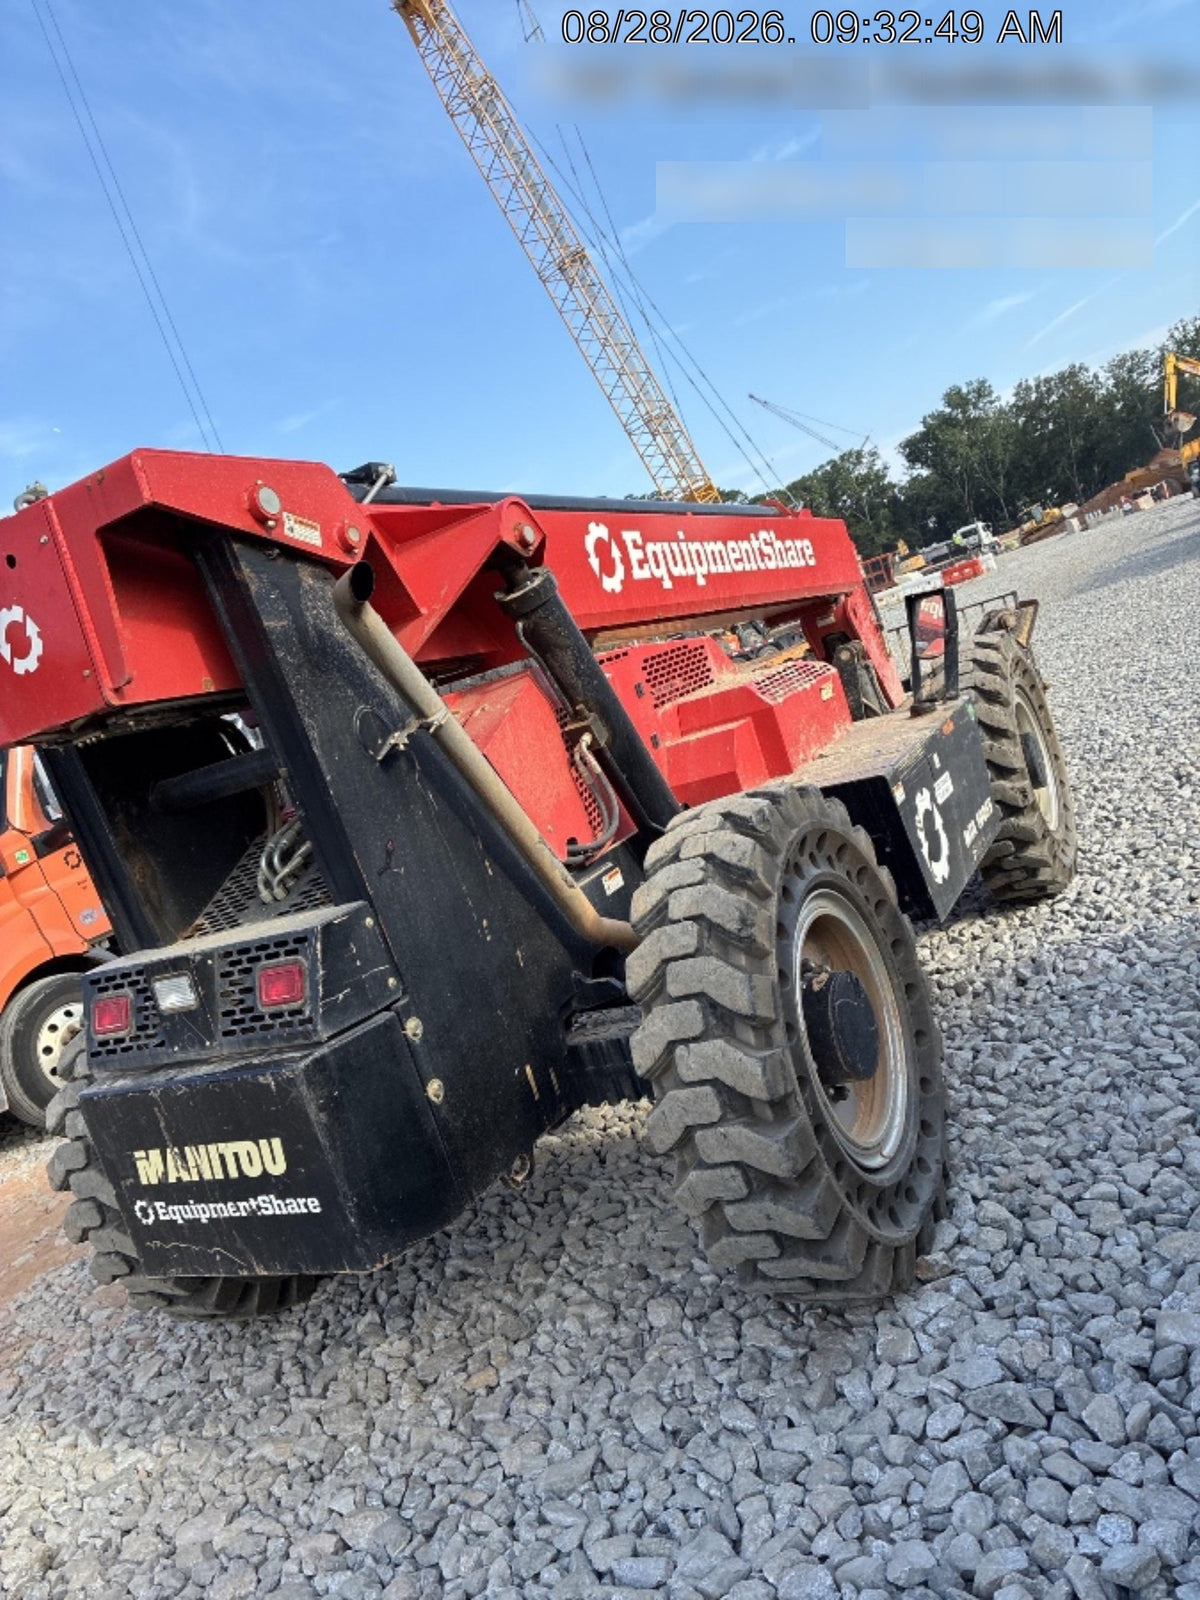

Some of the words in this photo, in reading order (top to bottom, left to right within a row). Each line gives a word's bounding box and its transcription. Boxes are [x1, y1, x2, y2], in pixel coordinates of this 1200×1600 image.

[621, 529, 816, 589] EquipmentShare
[133, 1137, 287, 1185] MANITOU
[154, 1194, 322, 1224] EquipmentShare
